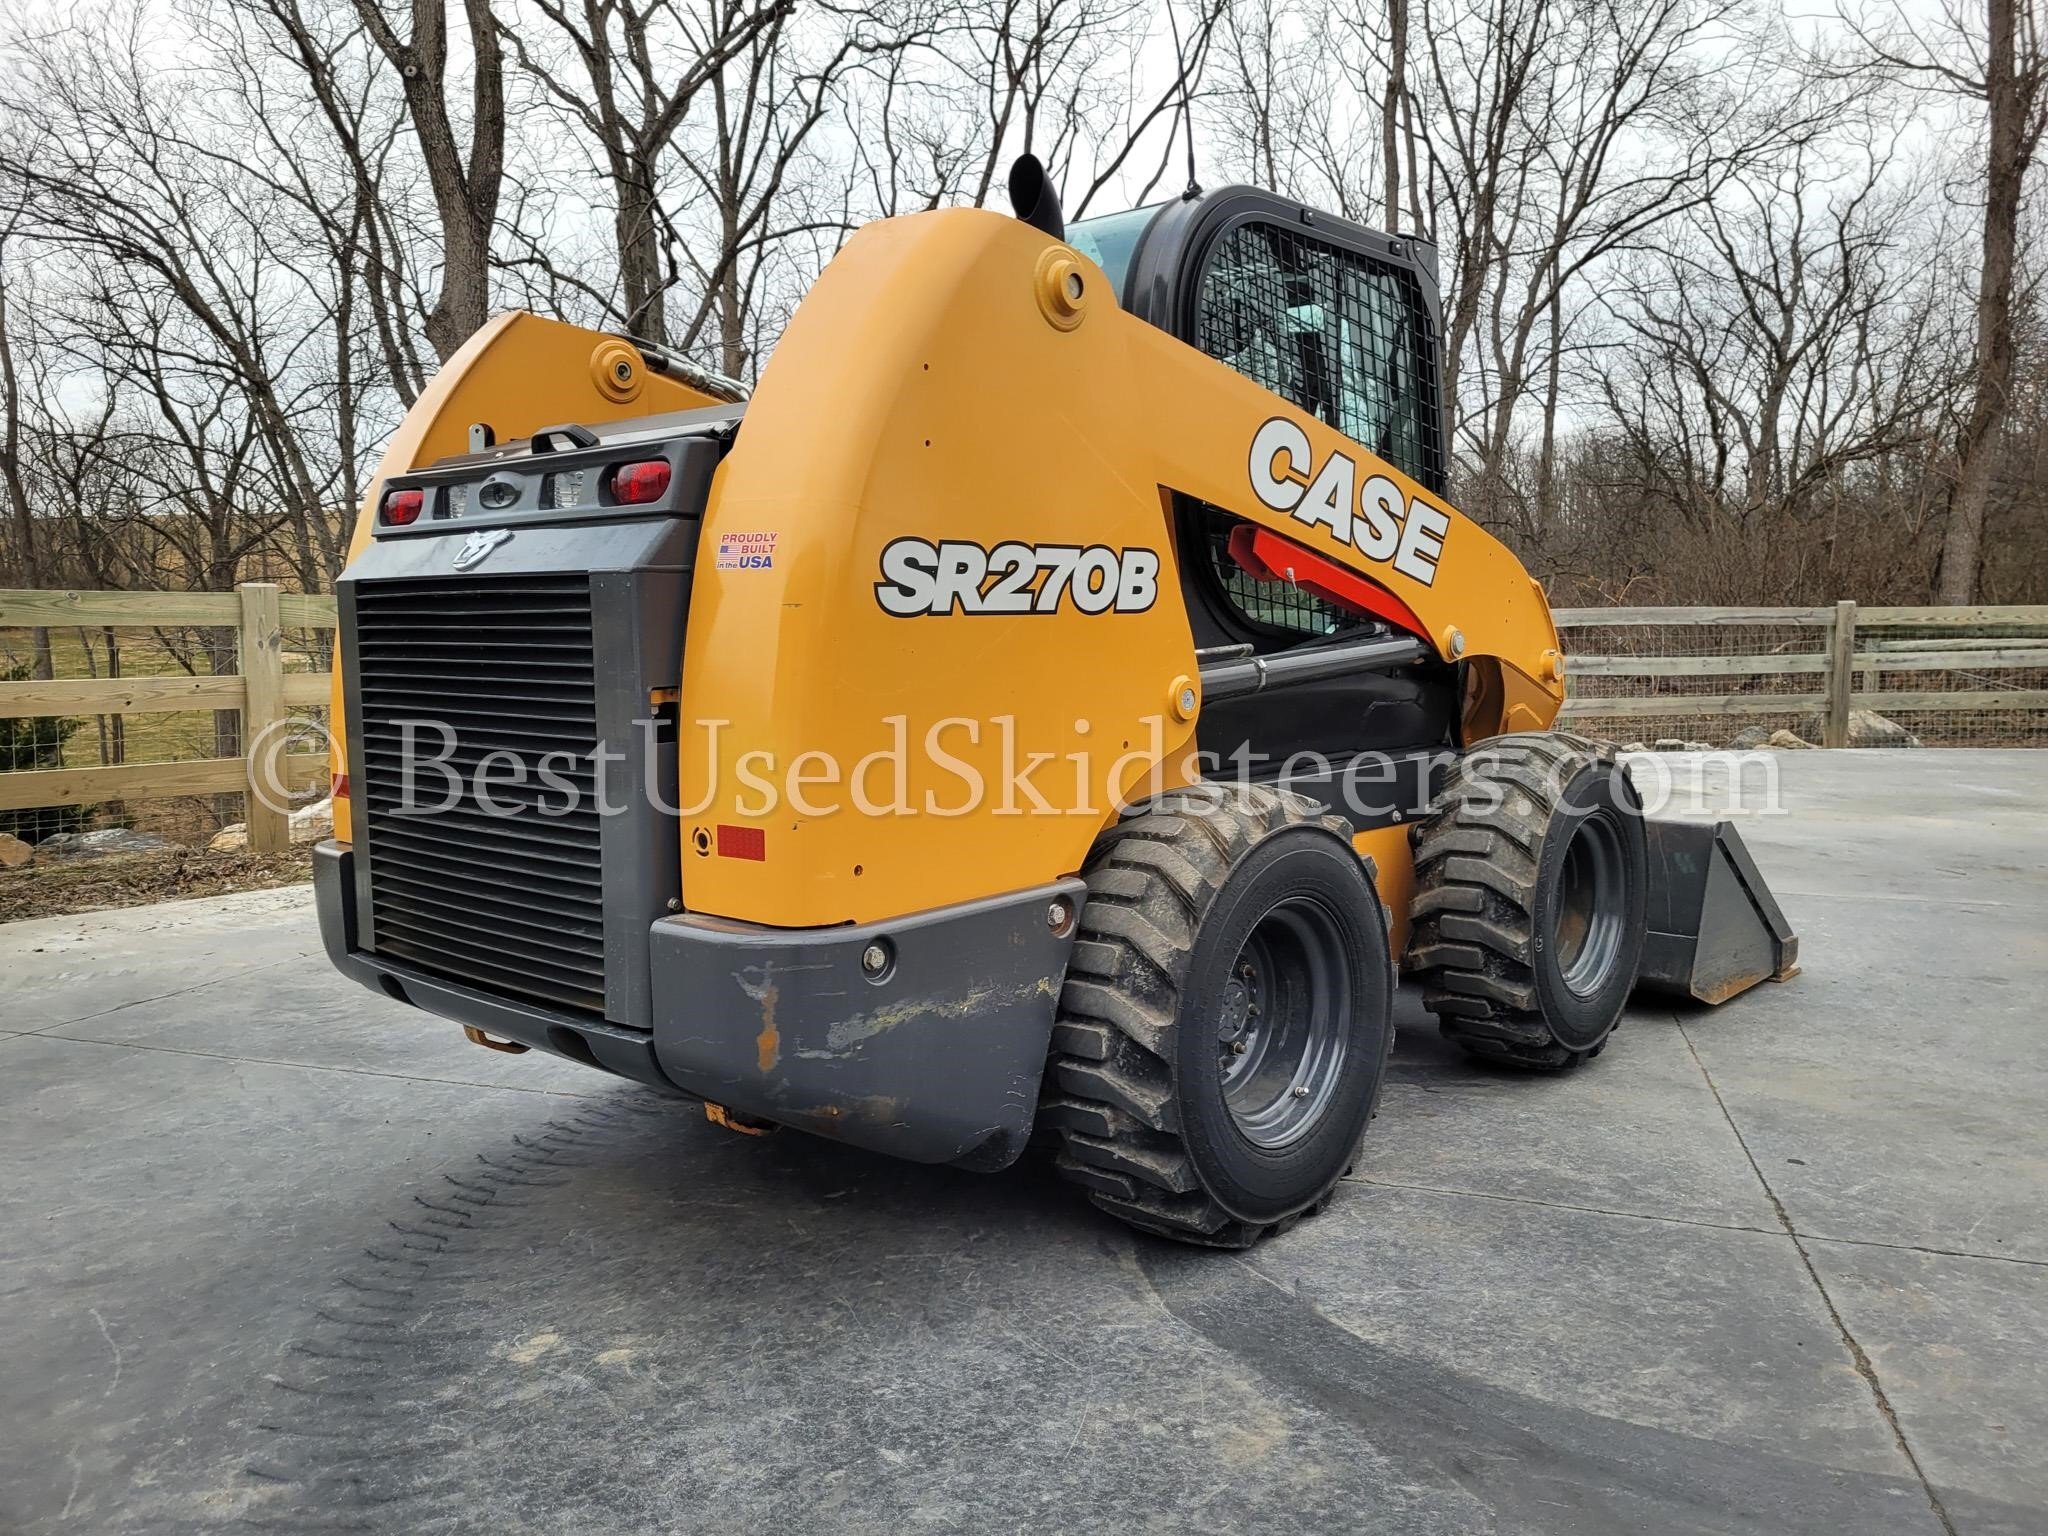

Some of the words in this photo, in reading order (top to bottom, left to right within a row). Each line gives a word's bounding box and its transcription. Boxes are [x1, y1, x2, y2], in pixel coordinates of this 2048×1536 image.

[1248, 415, 1452, 589] CASE
[721, 533, 777, 543] PROUDLY
[741, 544, 776, 554] BUILT
[725, 561, 738, 569] the
[739, 555, 772, 569] USA
[873, 535, 1160, 618] SR270B
